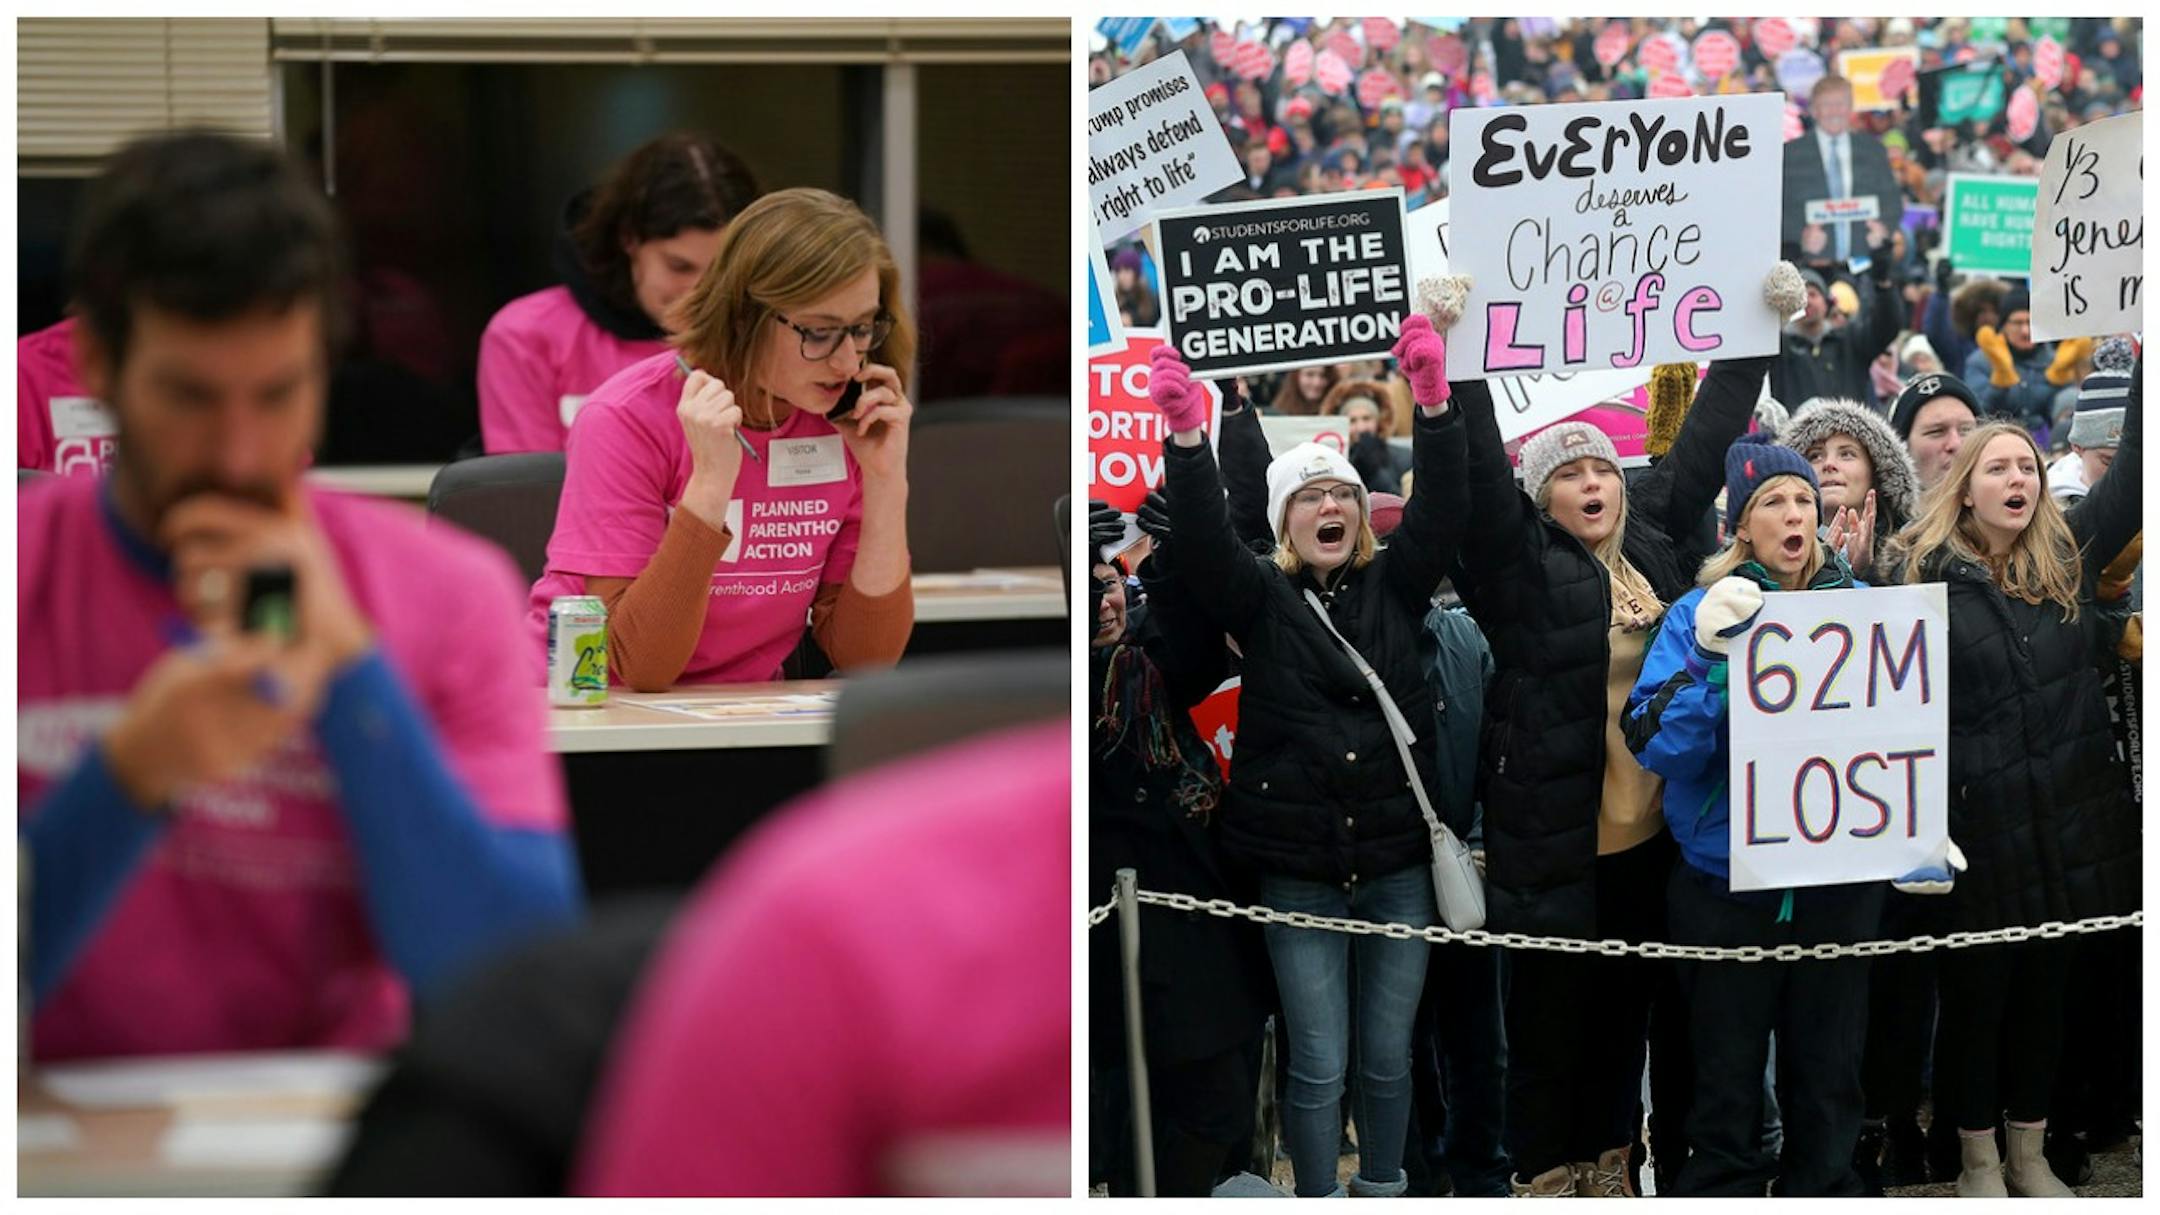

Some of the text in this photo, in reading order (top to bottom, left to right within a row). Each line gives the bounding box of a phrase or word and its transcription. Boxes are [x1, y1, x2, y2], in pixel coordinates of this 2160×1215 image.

[1088, 75, 1190, 136] rump promises
[1088, 109, 1204, 186] always defend
[2054, 138, 2099, 204] 1/3
[1100, 182, 1145, 222] right
[1144, 176, 1165, 199] to
[1575, 179, 1689, 214] deserves
[1613, 208, 1632, 227] a
[1961, 192, 1989, 210] ALL
[1211, 212, 1371, 240] STUDENTSFORLIFE.ORG
[1180, 232, 1385, 278] I AM THE
[1506, 217, 1701, 291] Chance
[1172, 264, 1404, 323] PRO-LIFE
[1595, 281, 1625, 312] @
[2064, 274, 2088, 317] is
[1181, 311, 1401, 360] GENERATION
[1091, 364, 1151, 398] TO
[751, 499, 829, 518] PLANNED
[743, 542, 813, 560] ACTION
[709, 579, 778, 596] renthood
[1747, 619, 1930, 715] 62M
[1746, 748, 1935, 846] LOST
